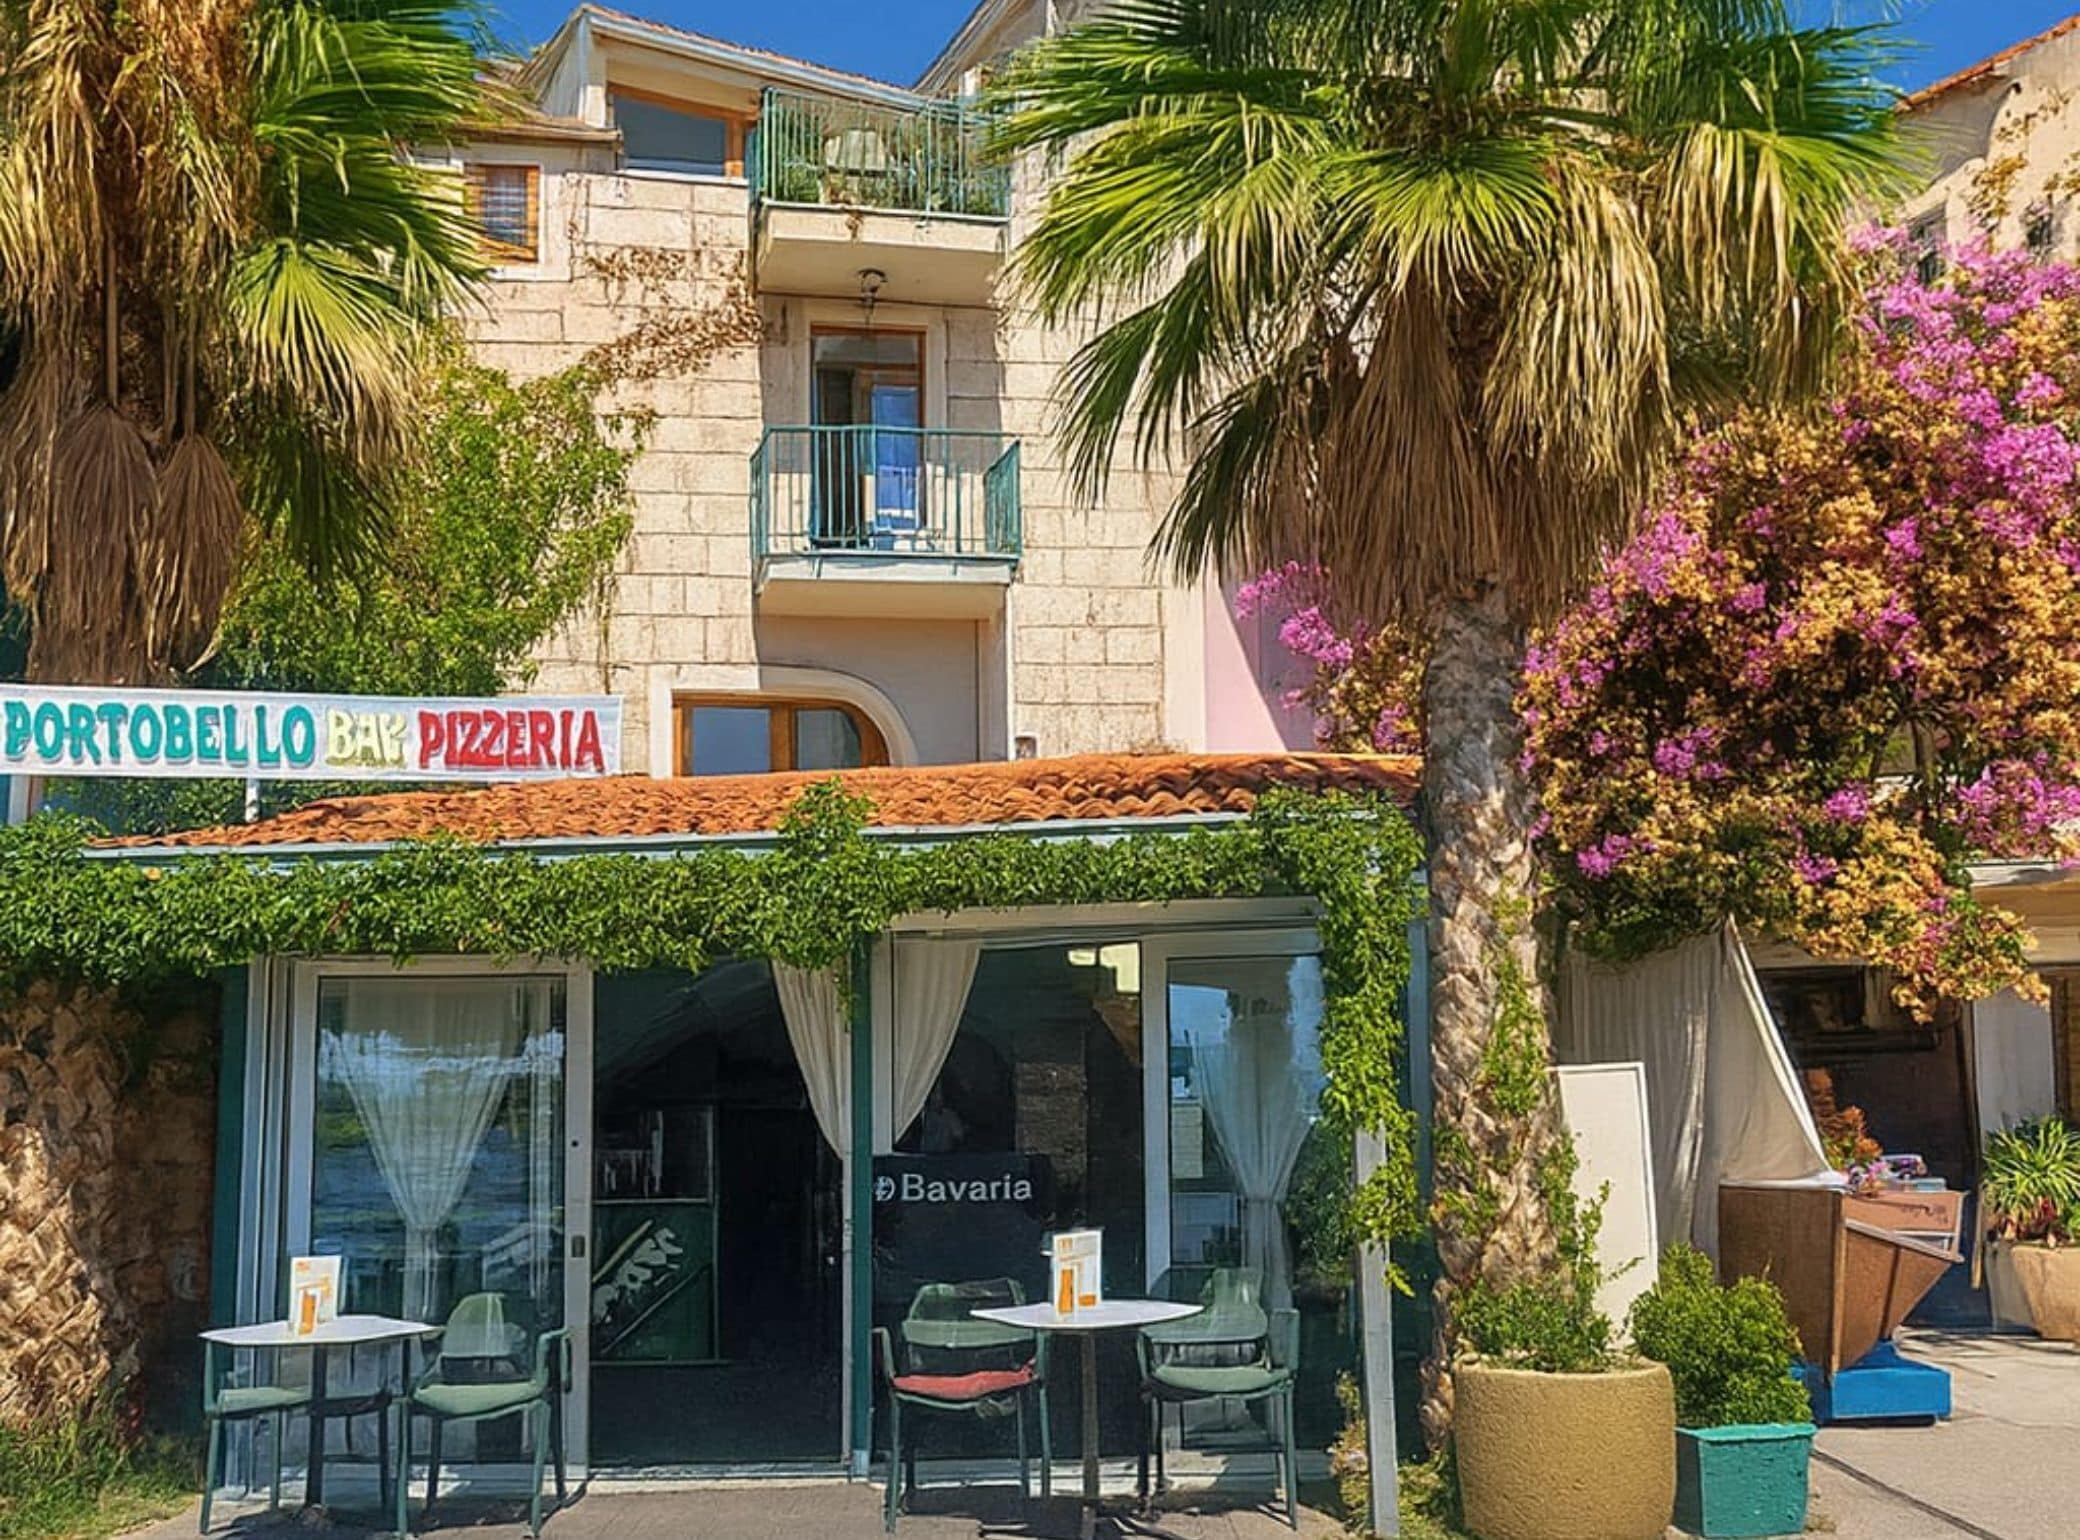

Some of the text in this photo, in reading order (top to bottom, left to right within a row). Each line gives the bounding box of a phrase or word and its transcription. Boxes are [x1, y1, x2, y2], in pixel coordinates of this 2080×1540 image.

[4, 700, 606, 773] PORTOBELLO BAR PIZZERIA
[901, 1173, 1033, 1201] Bavaria
